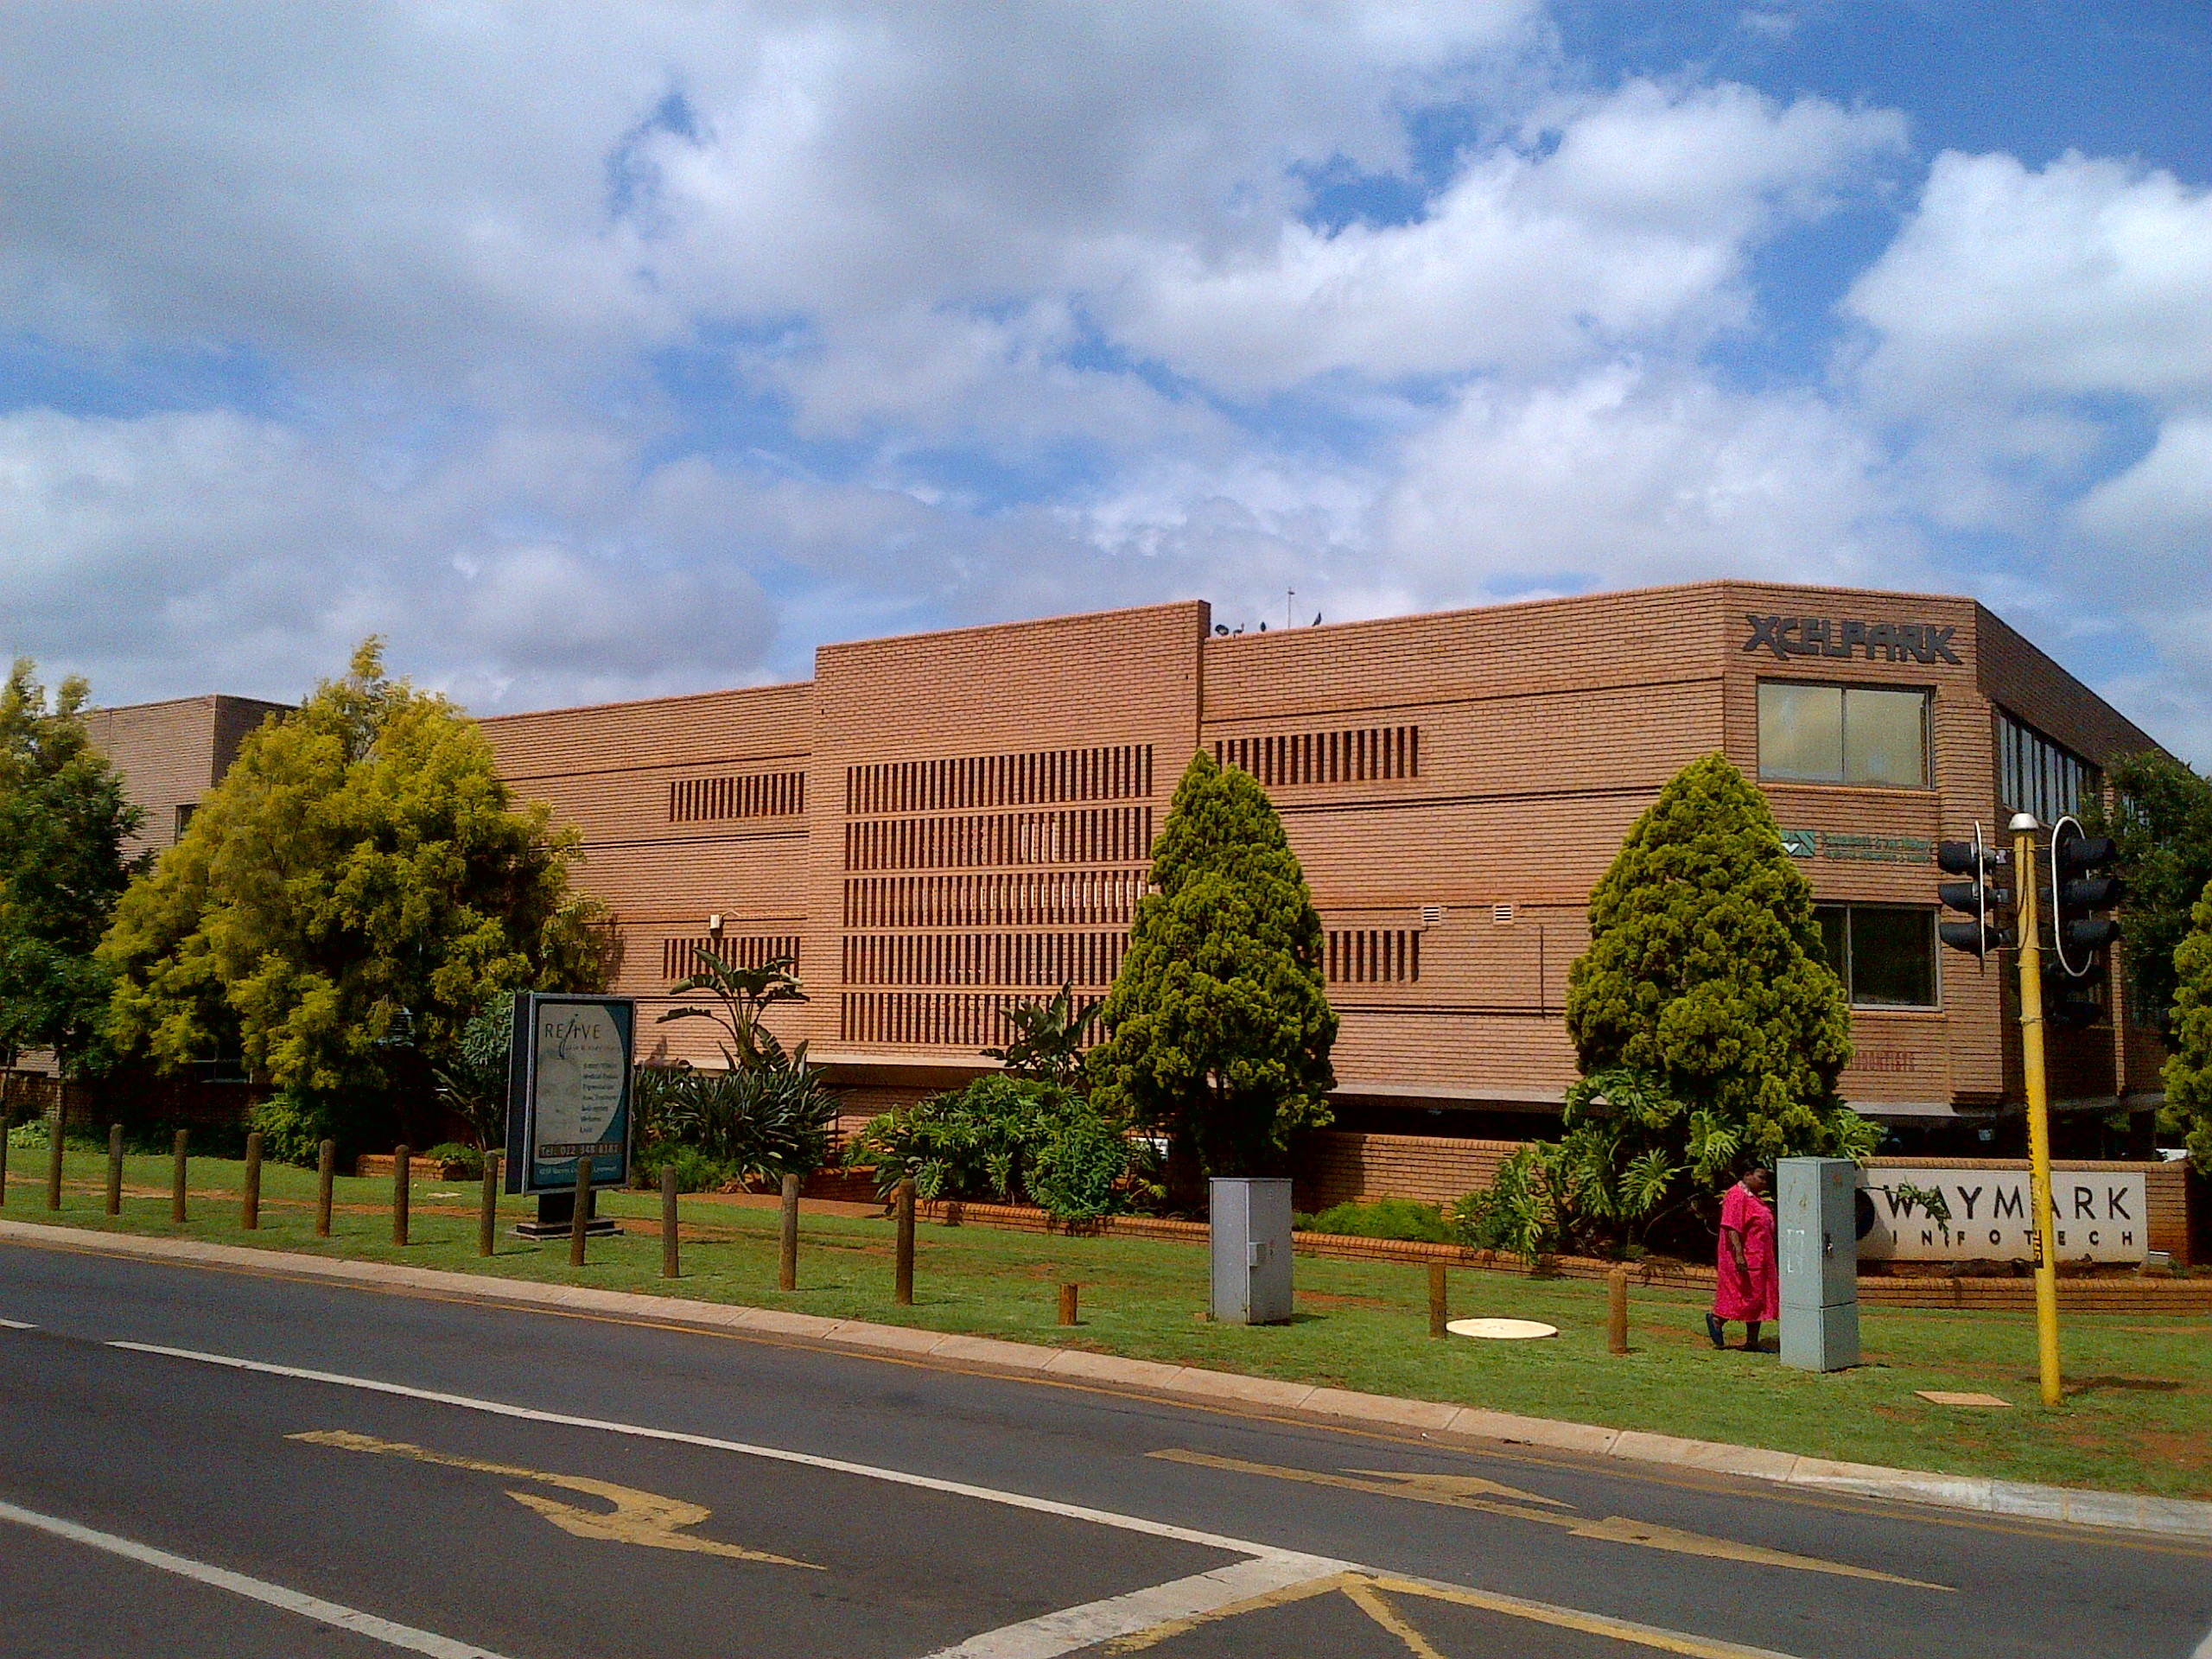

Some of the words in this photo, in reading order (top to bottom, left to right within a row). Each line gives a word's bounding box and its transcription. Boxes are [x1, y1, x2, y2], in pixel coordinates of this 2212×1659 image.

[1743, 614, 1963, 664] XCELPARK
[560, 1145, 576, 1155] 012
[1892, 1230, 2133, 1246] INFOTECH
